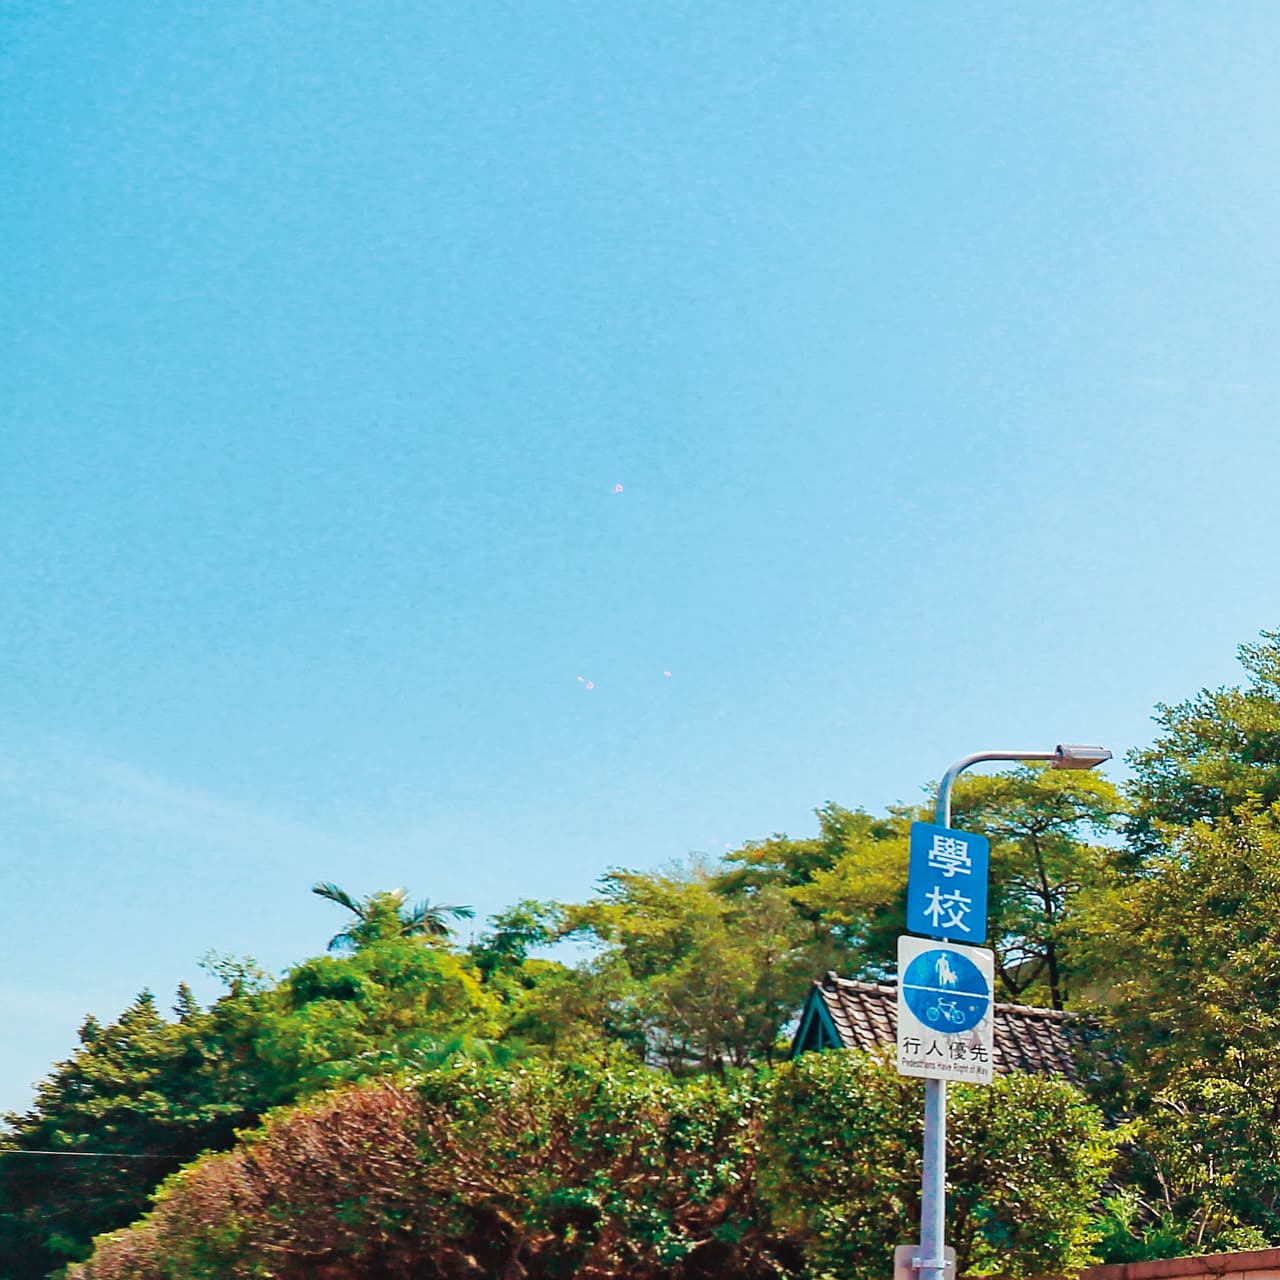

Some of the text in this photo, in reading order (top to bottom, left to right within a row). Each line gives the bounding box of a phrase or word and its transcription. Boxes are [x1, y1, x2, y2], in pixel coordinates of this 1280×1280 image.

[923, 835, 972, 932] 學校
[903, 1036, 988, 1062] 行人優先
